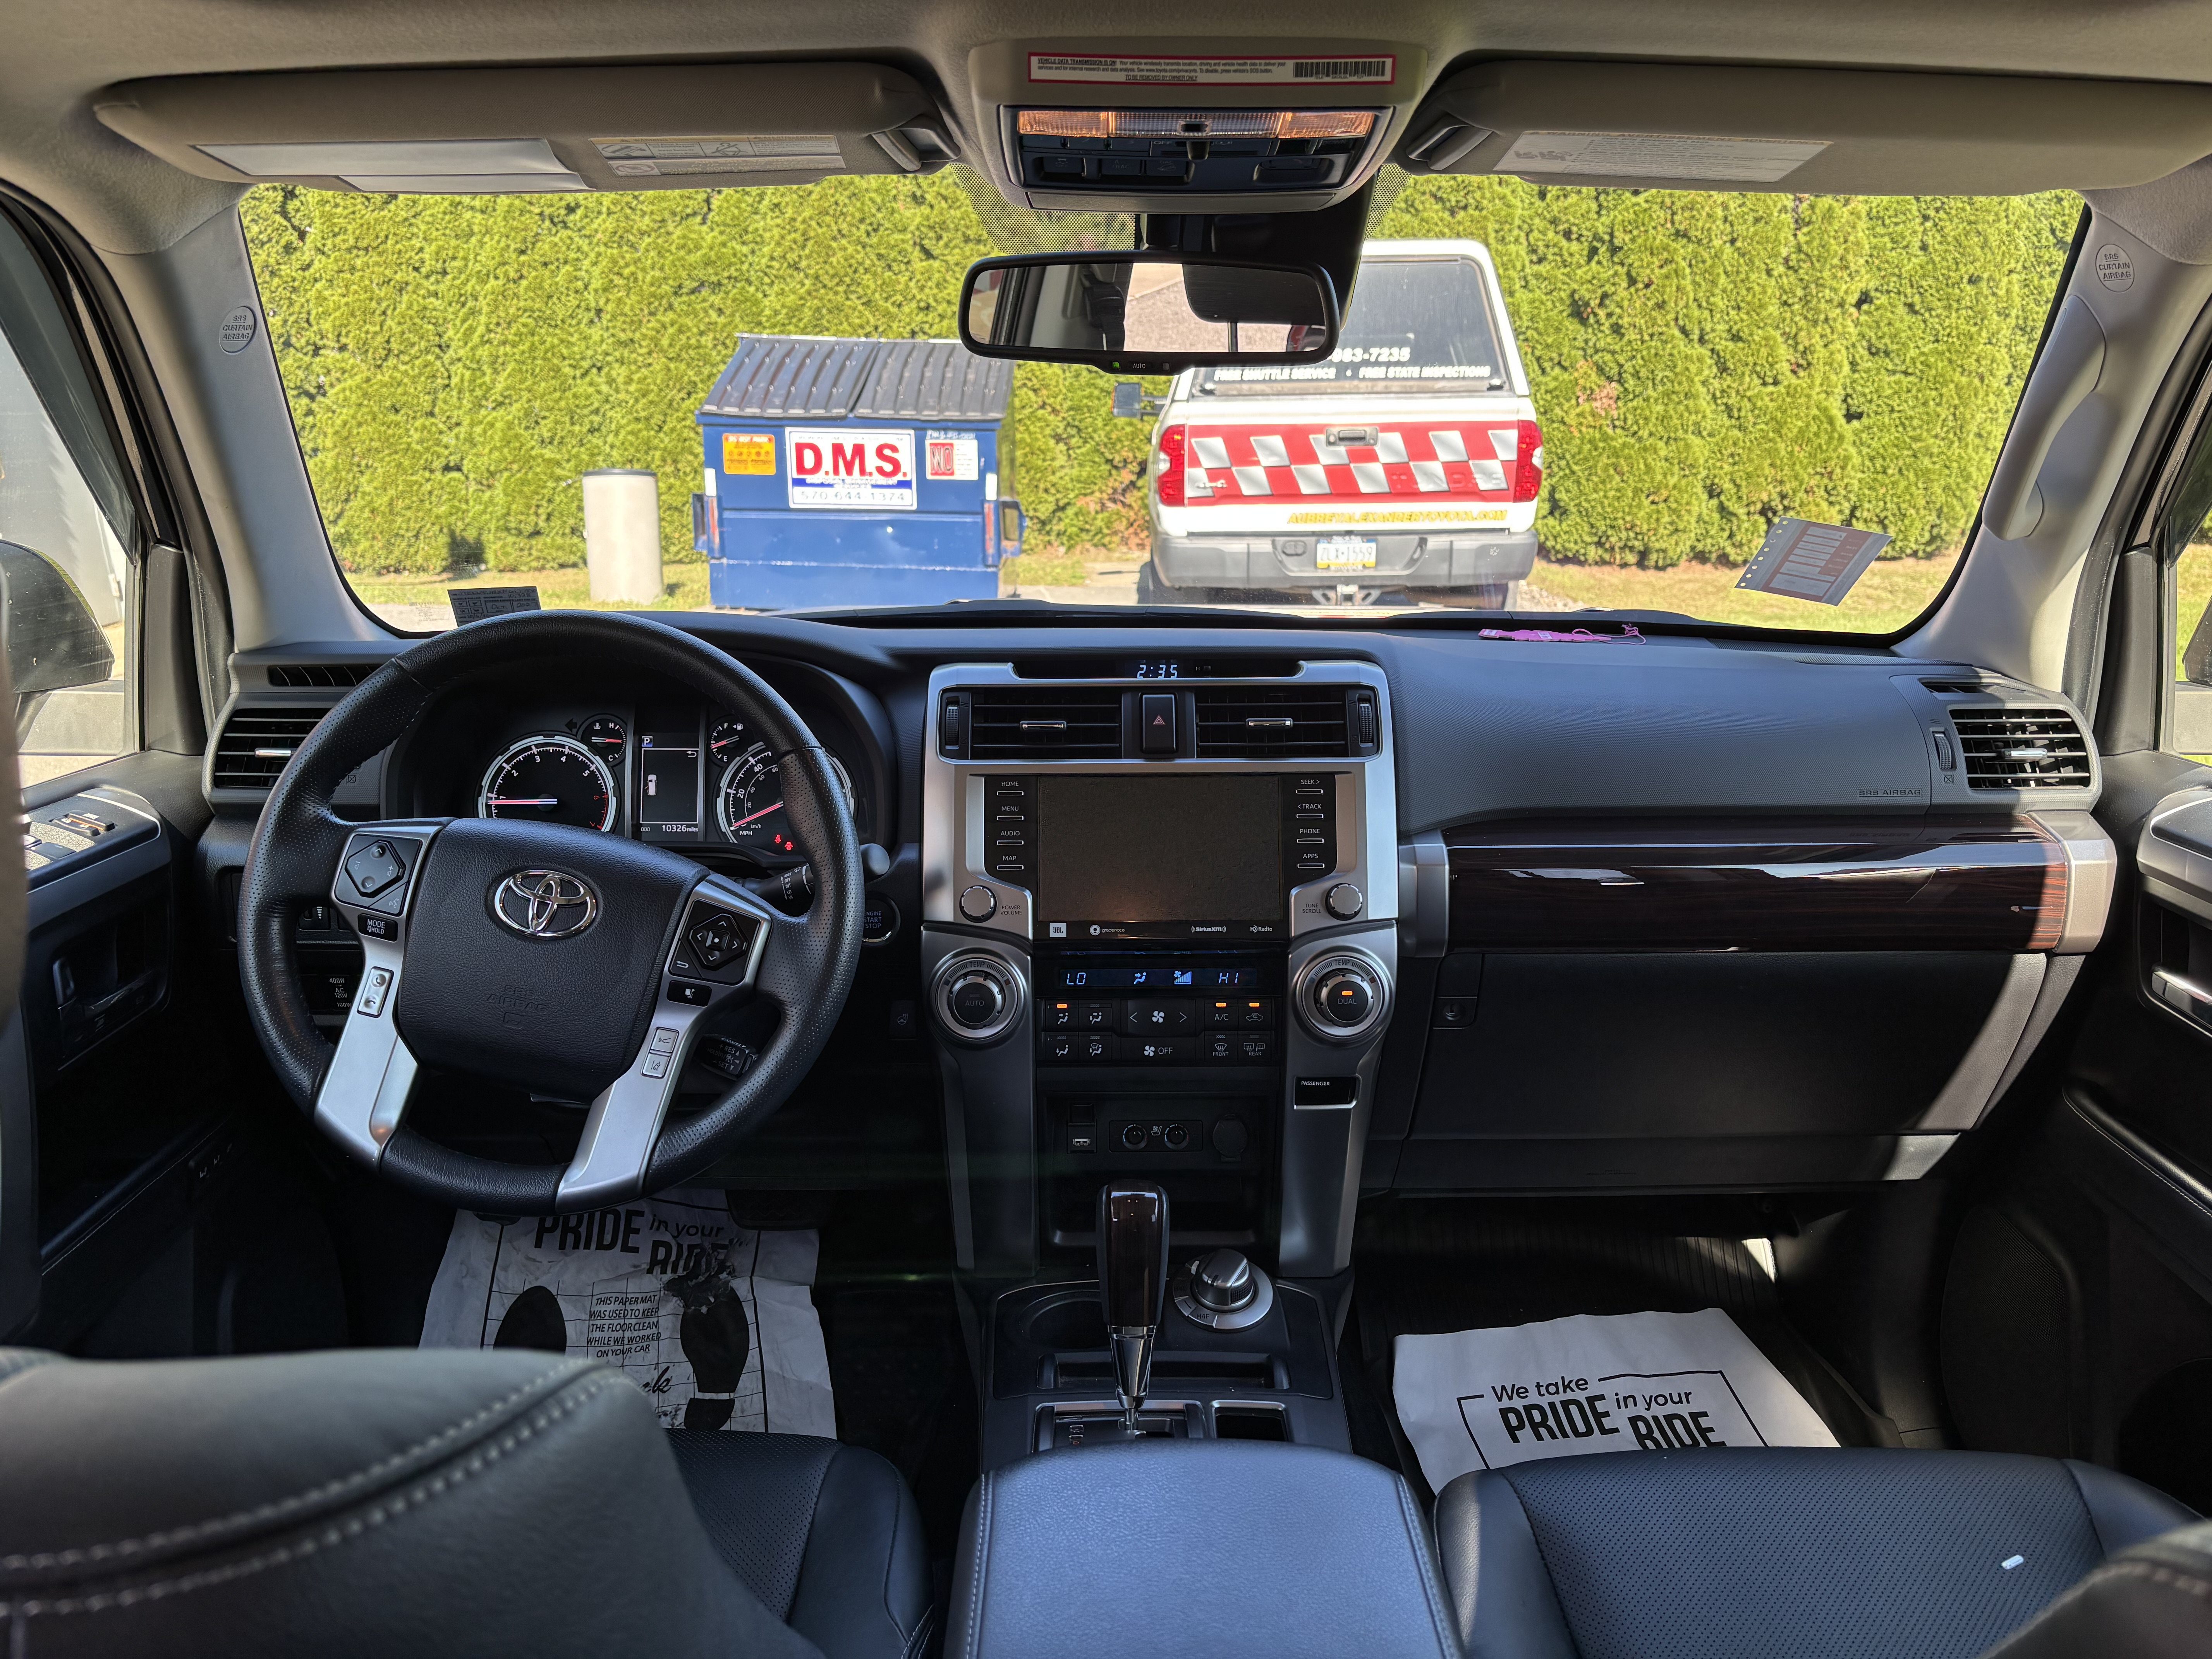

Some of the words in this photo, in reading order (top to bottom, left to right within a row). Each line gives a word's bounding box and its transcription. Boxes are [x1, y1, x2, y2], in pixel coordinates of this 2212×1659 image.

[2099, 262, 2130, 271] CURTAIN
[2103, 271, 2131, 280] AIRBAG
[1214, 369, 1242, 381] FREE
[1242, 368, 1291, 380] SHUTTLE
[1291, 368, 1336, 380] SERVICE
[1358, 367, 1386, 379] FREE
[1387, 367, 1421, 378] STATE
[1421, 366, 1491, 378] INSPECTIONS
[795, 442, 907, 478] D.M.S.
[930, 446, 953, 472] NO
[1287, 510, 1507, 524] AUBREYALEXANDERTOYOTA.COM
[1137, 665, 1178, 678] 2:35
[754, 764, 763, 772] 40
[738, 789, 745, 799] 20
[367, 919, 386, 929] MODE
[1066, 972, 1086, 985] LO
[1218, 972, 1239, 984] HI
[721, 1038, 742, 1047] CANCEL
[724, 1046, 735, 1054] RES
[534, 1208, 645, 1254] PRIDE
[649, 1214, 669, 1231] in
[672, 1221, 724, 1239] your
[596, 1296, 613, 1305] THIS
[613, 1296, 639, 1305] PAPER
[640, 1295, 657, 1304] MAT
[589, 1310, 607, 1319] WAS
[608, 1309, 628, 1319] USED
[630, 1309, 640, 1317] TO
[642, 1307, 659, 1316] KEEP
[591, 1324, 605, 1333] THE
[607, 1323, 632, 1332] FLOOR
[633, 1321, 658, 1331] CLEAN
[587, 1336, 612, 1346] WHILE
[613, 1336, 625, 1345] WE
[627, 1332, 661, 1343] WORKED
[596, 1349, 609, 1358] ON
[611, 1347, 632, 1356] YOUR
[634, 1344, 650, 1352] CAR
[1491, 1383, 1529, 1401] We
[1535, 1376, 1589, 1397] take
[1498, 1394, 1620, 1443] PRIDE
[1614, 1392, 1637, 1410] in
[1642, 1390, 1692, 1411] your
[1626, 1411, 1727, 1449] RIDE
